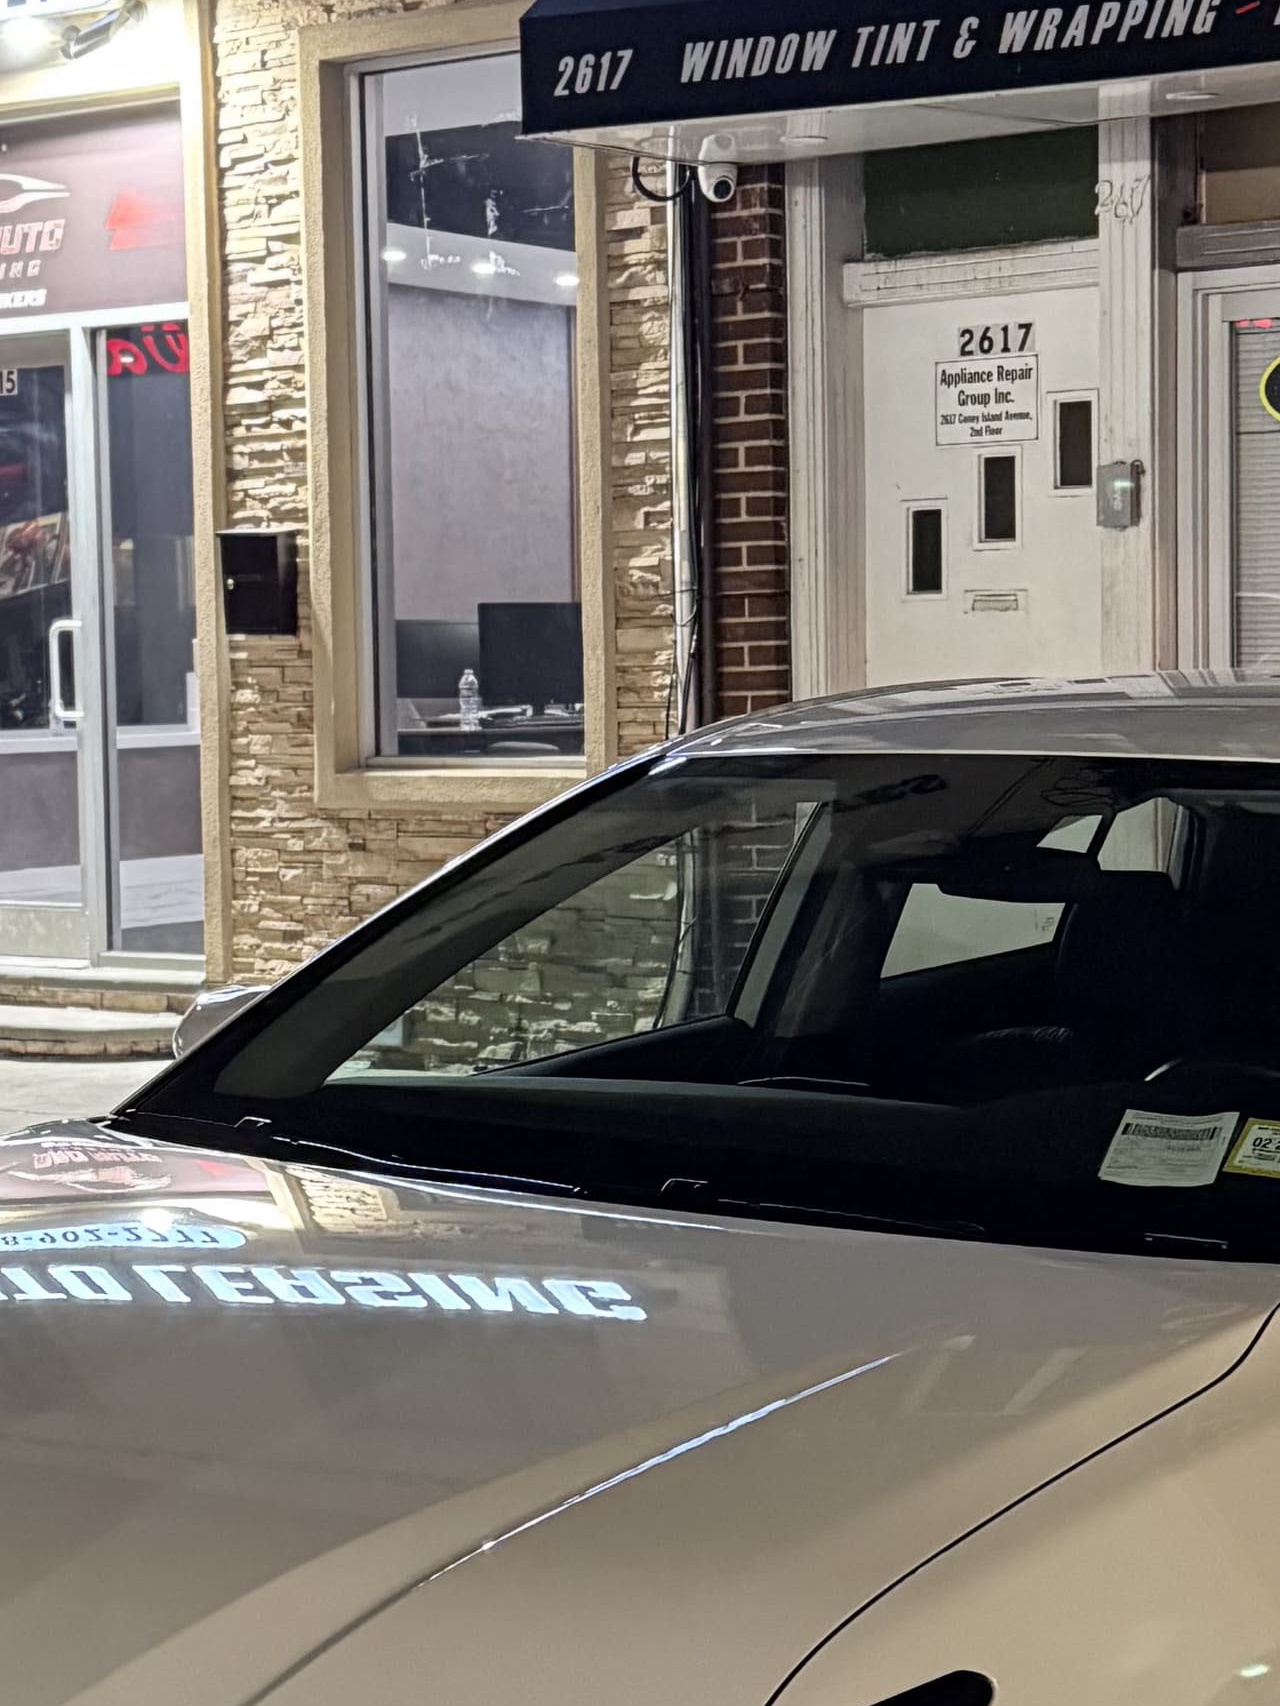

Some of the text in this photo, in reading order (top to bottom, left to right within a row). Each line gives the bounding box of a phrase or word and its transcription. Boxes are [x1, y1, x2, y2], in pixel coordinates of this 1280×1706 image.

[551, 48, 633, 97] 2617
[679, 29, 835, 84] WINDOW
[850, 18, 940, 69] TINT
[952, 16, 981, 59] &
[959, 323, 1033, 356] 2617
[940, 362, 1033, 389] Appliance Repair
[957, 387, 1015, 408] Group Inc.
[958, 413, 980, 424] Coney
[981, 411, 1003, 423] Island
[984, 425, 1003, 436] Floor
[1252, 1136, 1273, 1150] 02
